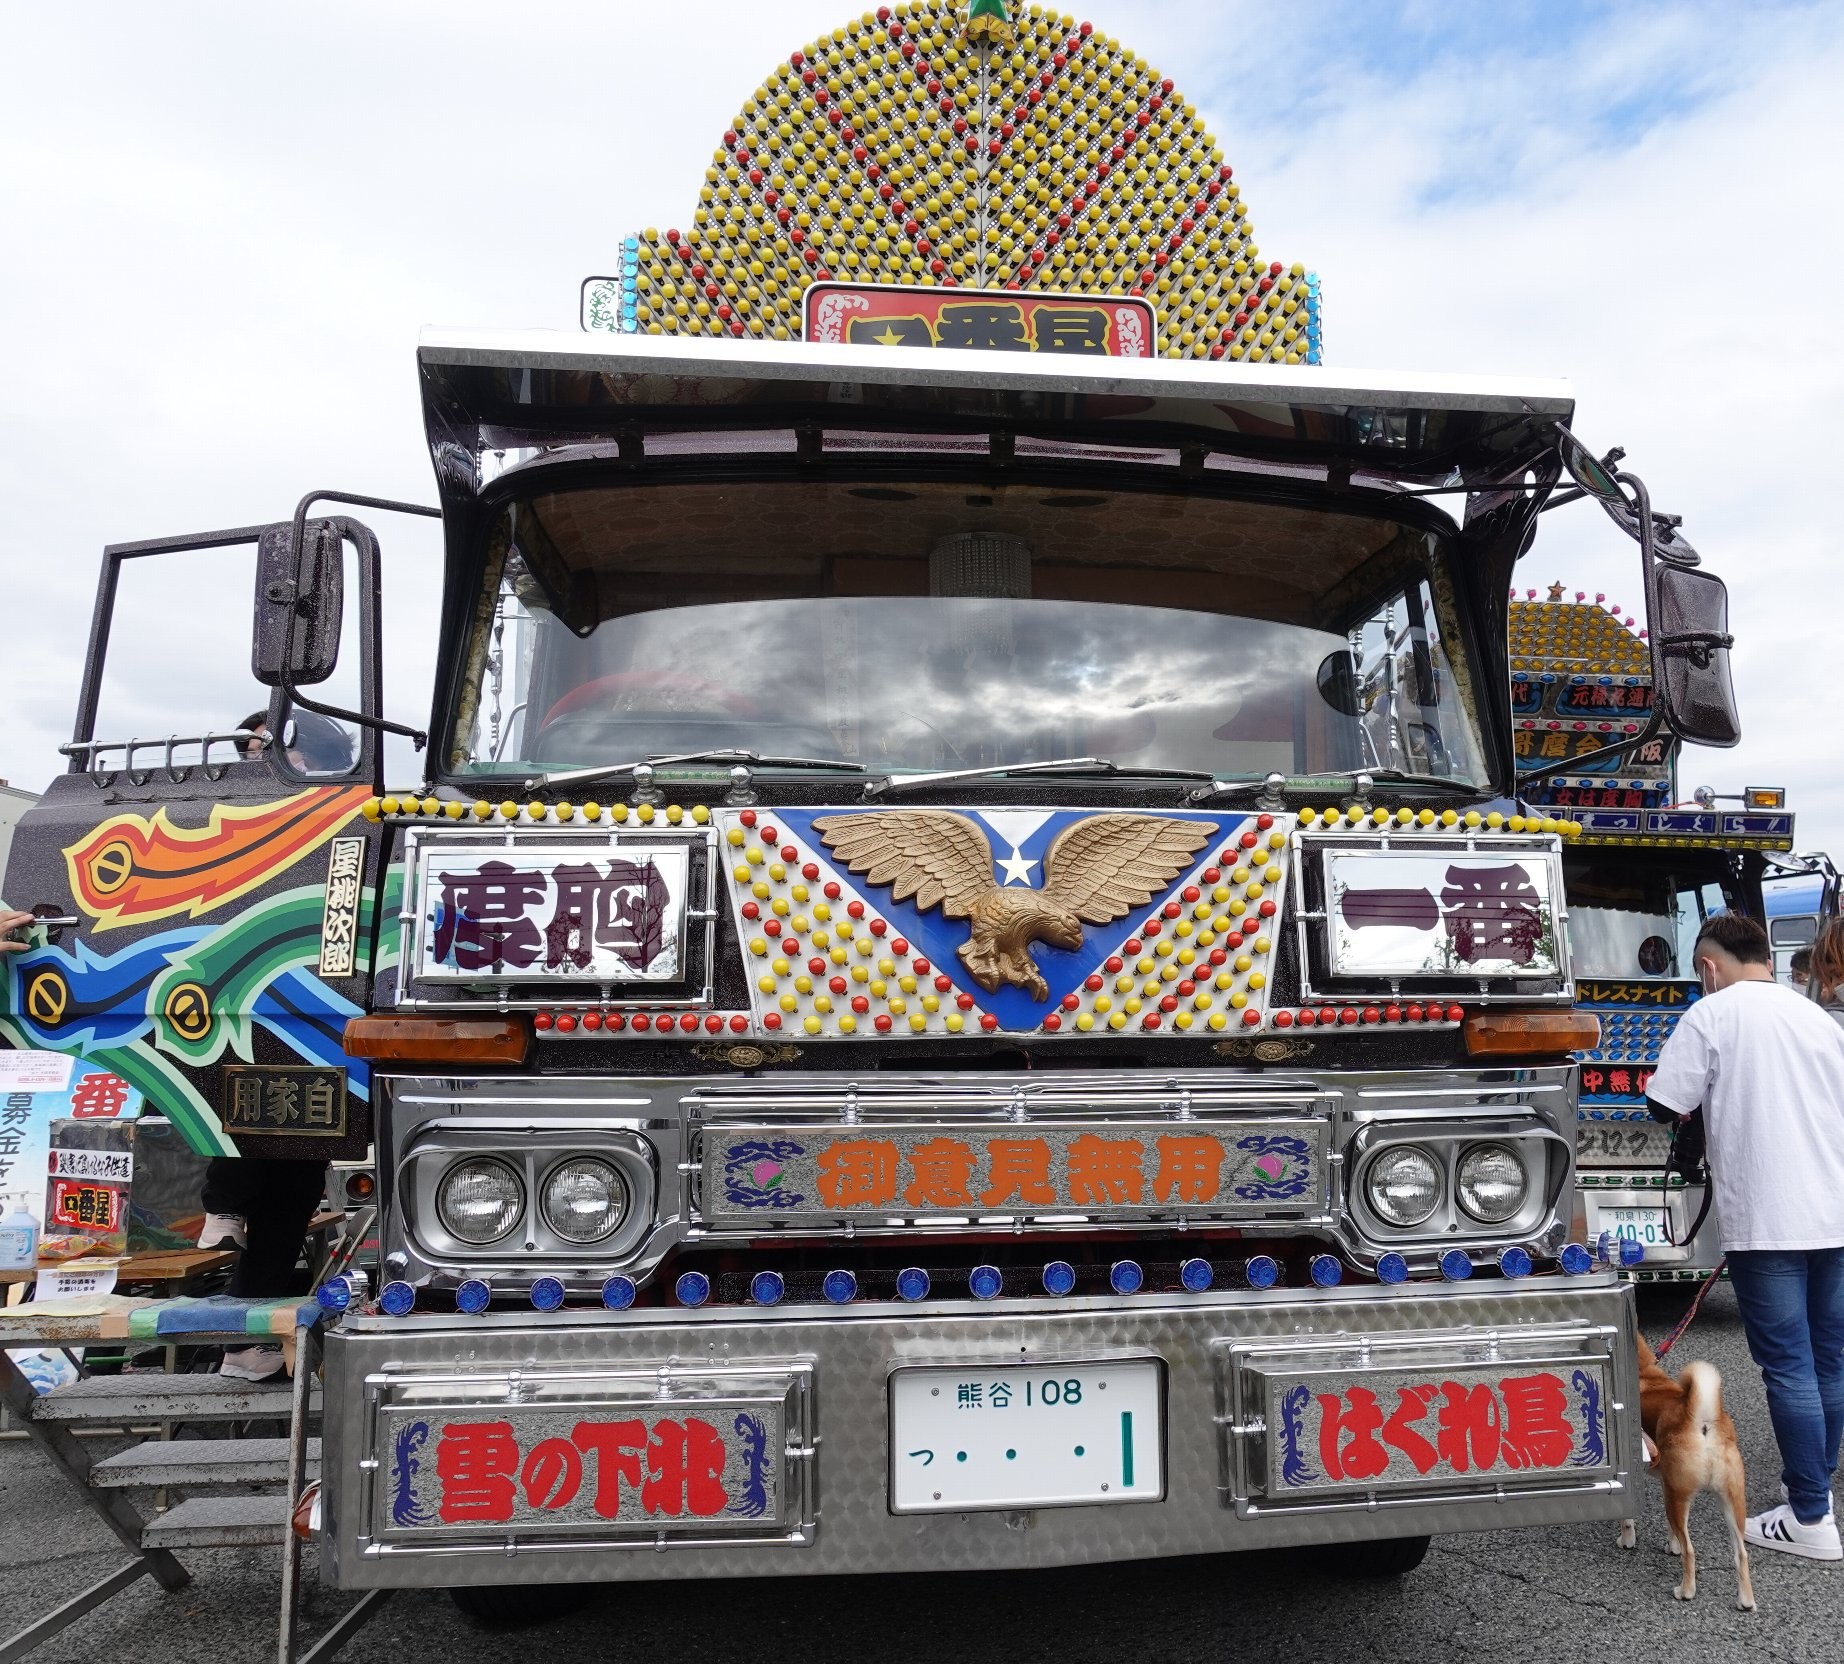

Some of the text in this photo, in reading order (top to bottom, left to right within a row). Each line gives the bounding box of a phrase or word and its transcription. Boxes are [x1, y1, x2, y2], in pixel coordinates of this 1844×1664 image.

[1640, 739, 1664, 762] 阪
[1556, 788, 1643, 808] 女は度胸
[323, 841, 359, 972] 星桃次郎
[433, 860, 670, 969] 度胸
[1341, 863, 1543, 965] 一番
[1576, 984, 1682, 1003] ドレスナイト
[815, 1134, 1226, 1209] 御意見無用
[436, 1419, 729, 1524] 雪の下北
